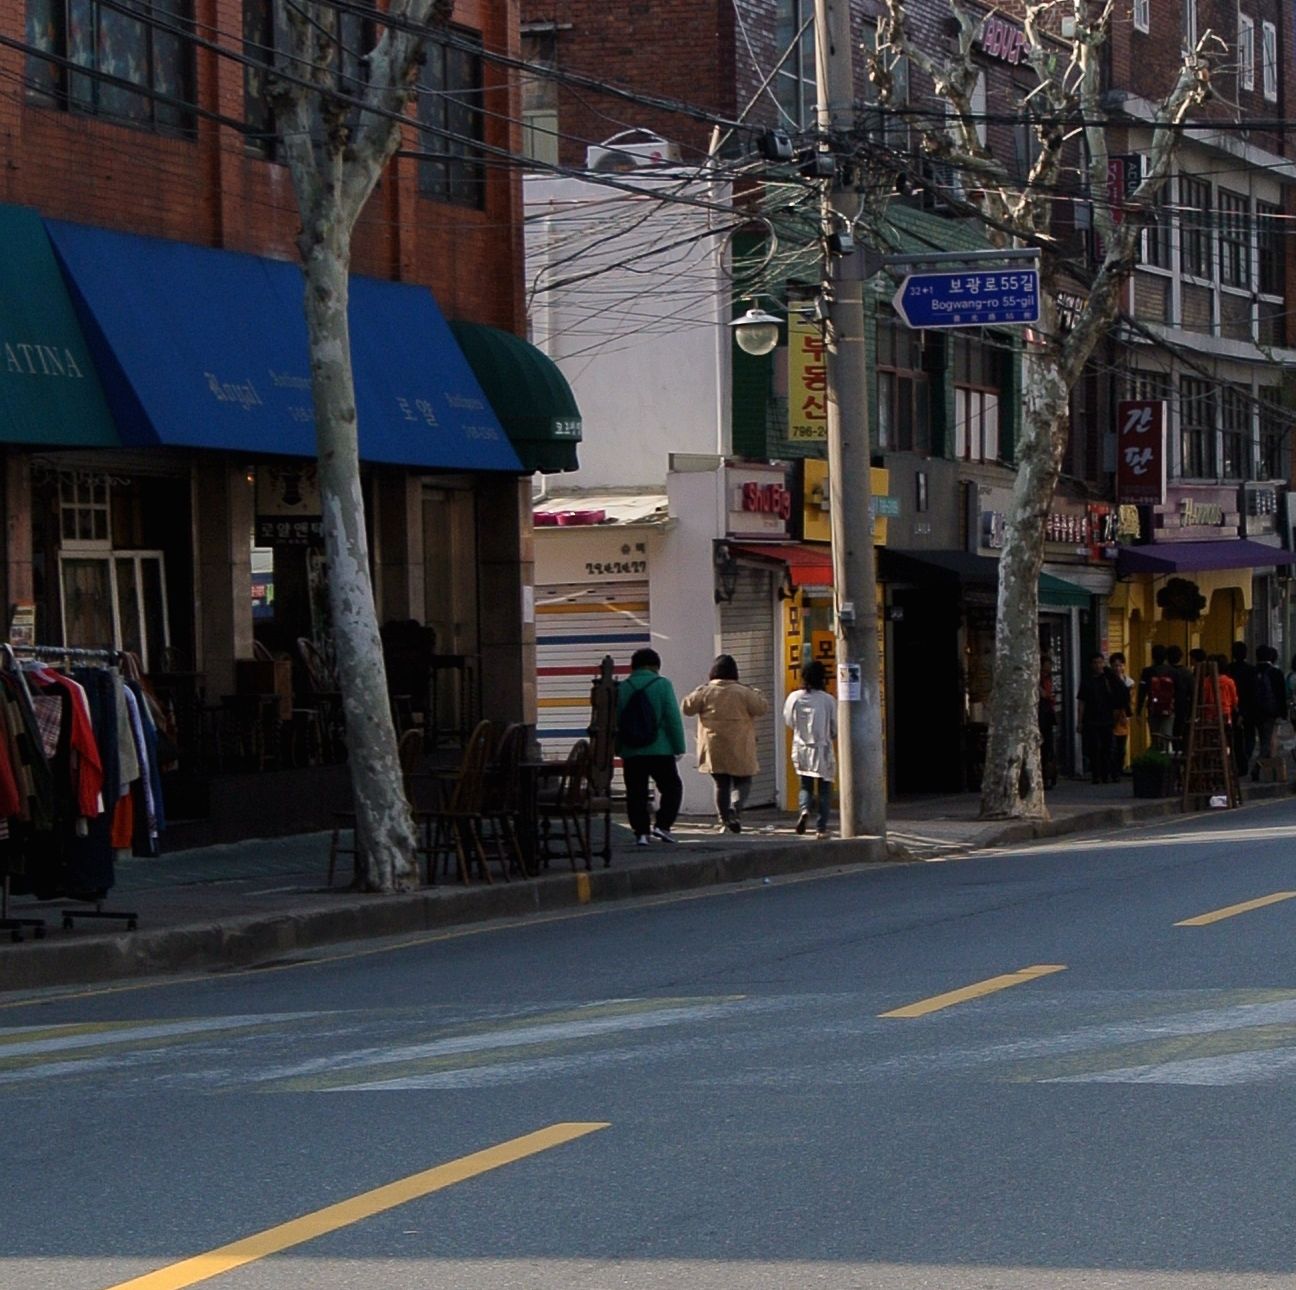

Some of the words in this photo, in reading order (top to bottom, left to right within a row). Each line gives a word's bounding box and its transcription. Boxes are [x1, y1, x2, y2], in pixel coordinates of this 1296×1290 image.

[949, 274, 1034, 294] 보광로55길
[931, 299, 999, 312] Bogwang-ro
[1002, 295, 1035, 308] 55-gil
[5, 342, 84, 378] ATINA
[801, 335, 827, 420] 부동산
[793, 426, 828, 438] 796-2
[1123, 407, 1154, 476] 간판
